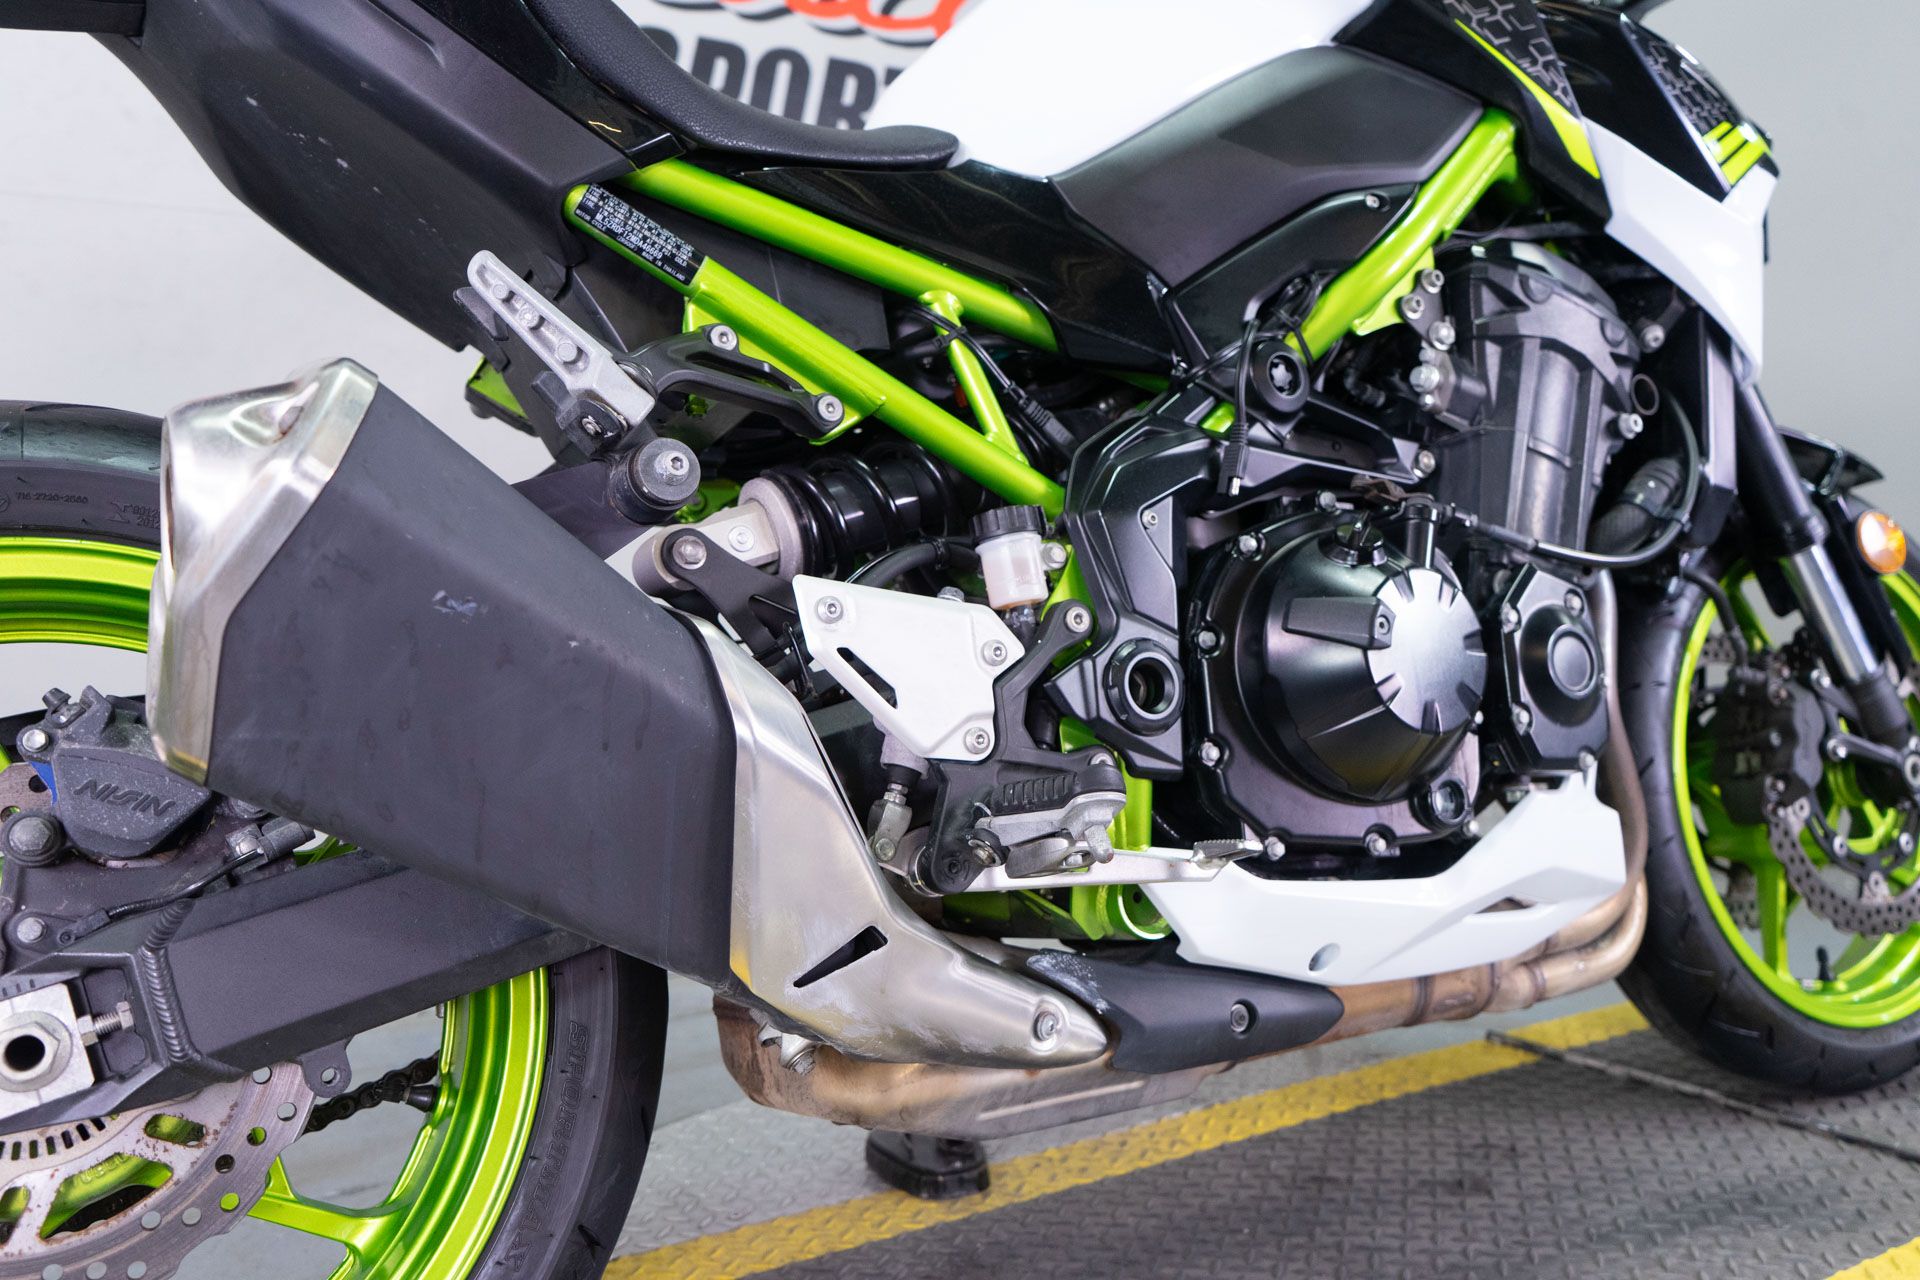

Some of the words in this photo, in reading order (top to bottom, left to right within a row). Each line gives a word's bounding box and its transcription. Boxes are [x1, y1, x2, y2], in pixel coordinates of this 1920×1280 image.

[640, 27, 905, 130] POR
[590, 219, 606, 231] CYCLE
[662, 264, 685, 281] THAILAND
